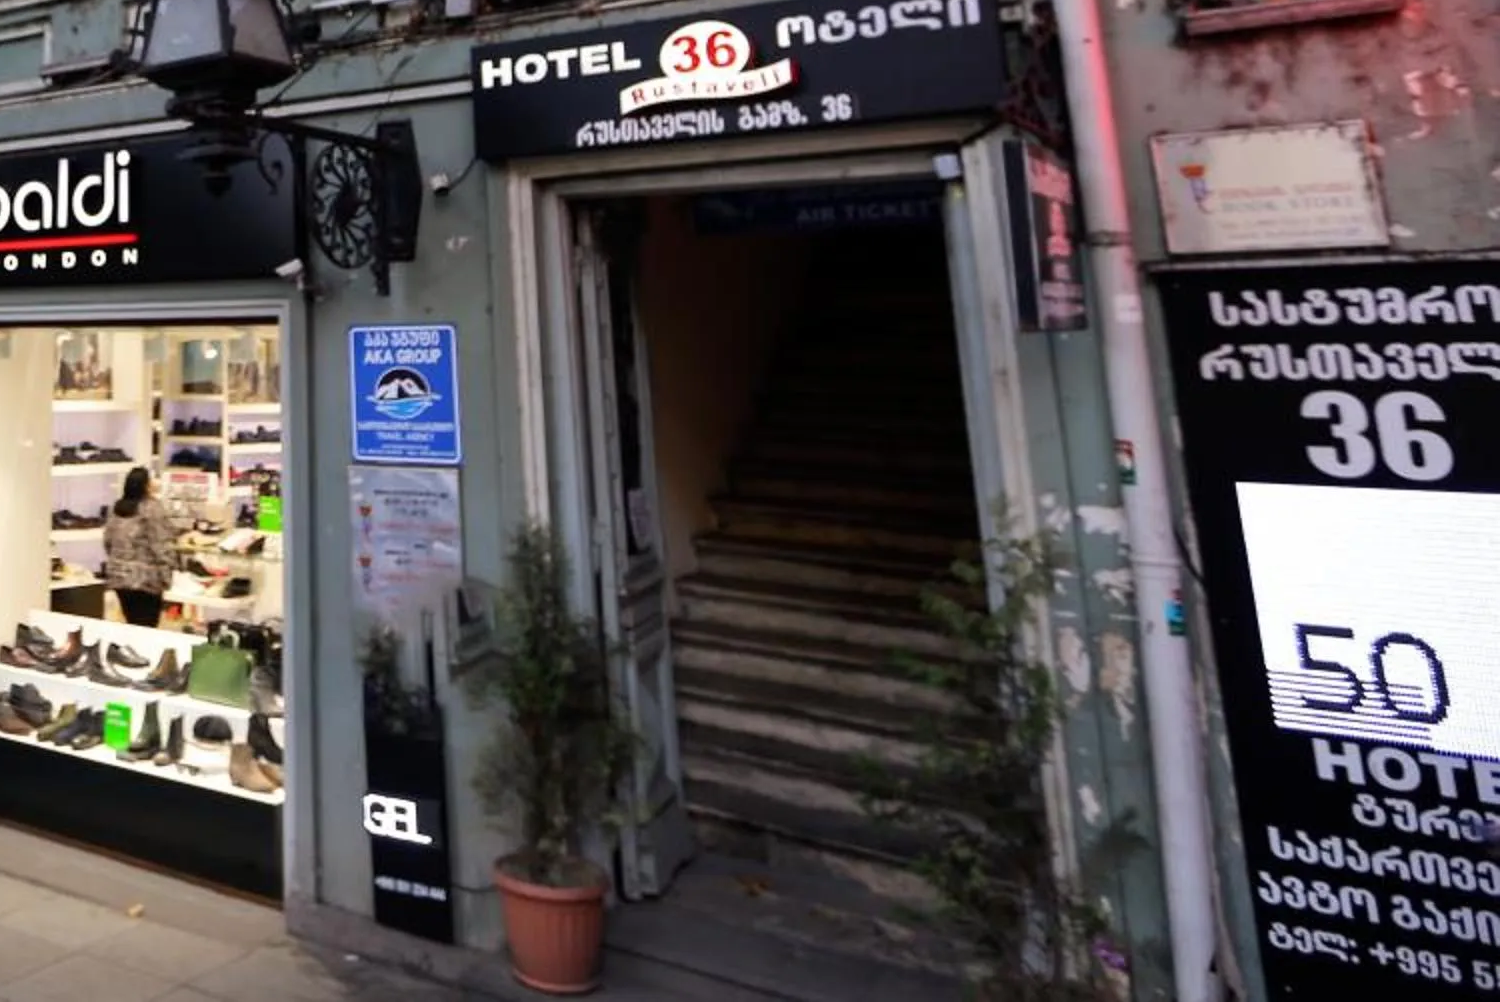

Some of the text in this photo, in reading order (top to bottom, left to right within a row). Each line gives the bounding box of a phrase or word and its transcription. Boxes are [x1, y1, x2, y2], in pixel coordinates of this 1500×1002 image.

[481, 30, 738, 89] HOTEL 36
[631, 71, 782, 104] Rustaveli
[576, 108, 725, 147] რუსთაველის
[821, 94, 853, 121] 36
[1208, 284, 1500, 326] სასტუმრო
[364, 348, 442, 365] AKA GROUP
[1300, 389, 1455, 482] 36
[1293, 623, 1451, 725] 50
[1258, 870, 1381, 924] ავტო
[1368, 941, 1463, 984] +995
[1472, 959, 1500, 990] 5
